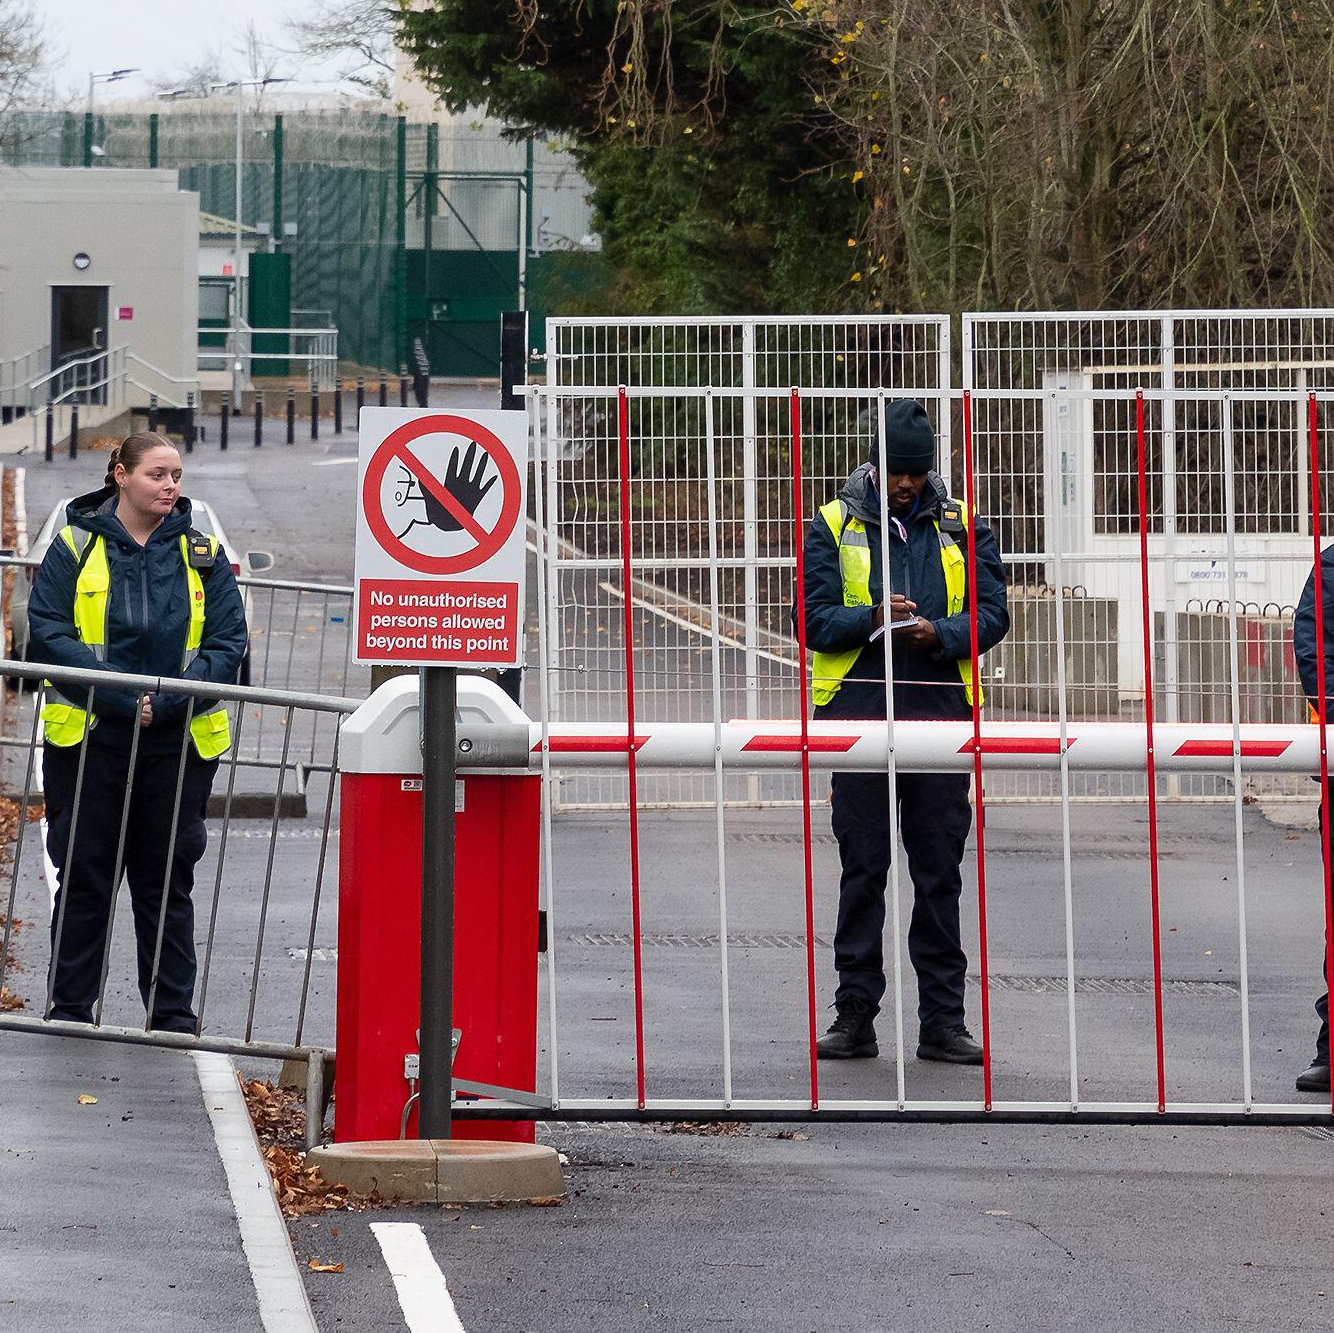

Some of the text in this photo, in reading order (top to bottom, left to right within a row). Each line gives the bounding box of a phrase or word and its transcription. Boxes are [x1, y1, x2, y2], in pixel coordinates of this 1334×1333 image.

[370, 590, 507, 609] No unauthorised
[370, 613, 506, 631] persons allowed
[366, 632, 509, 654] beyond this point
